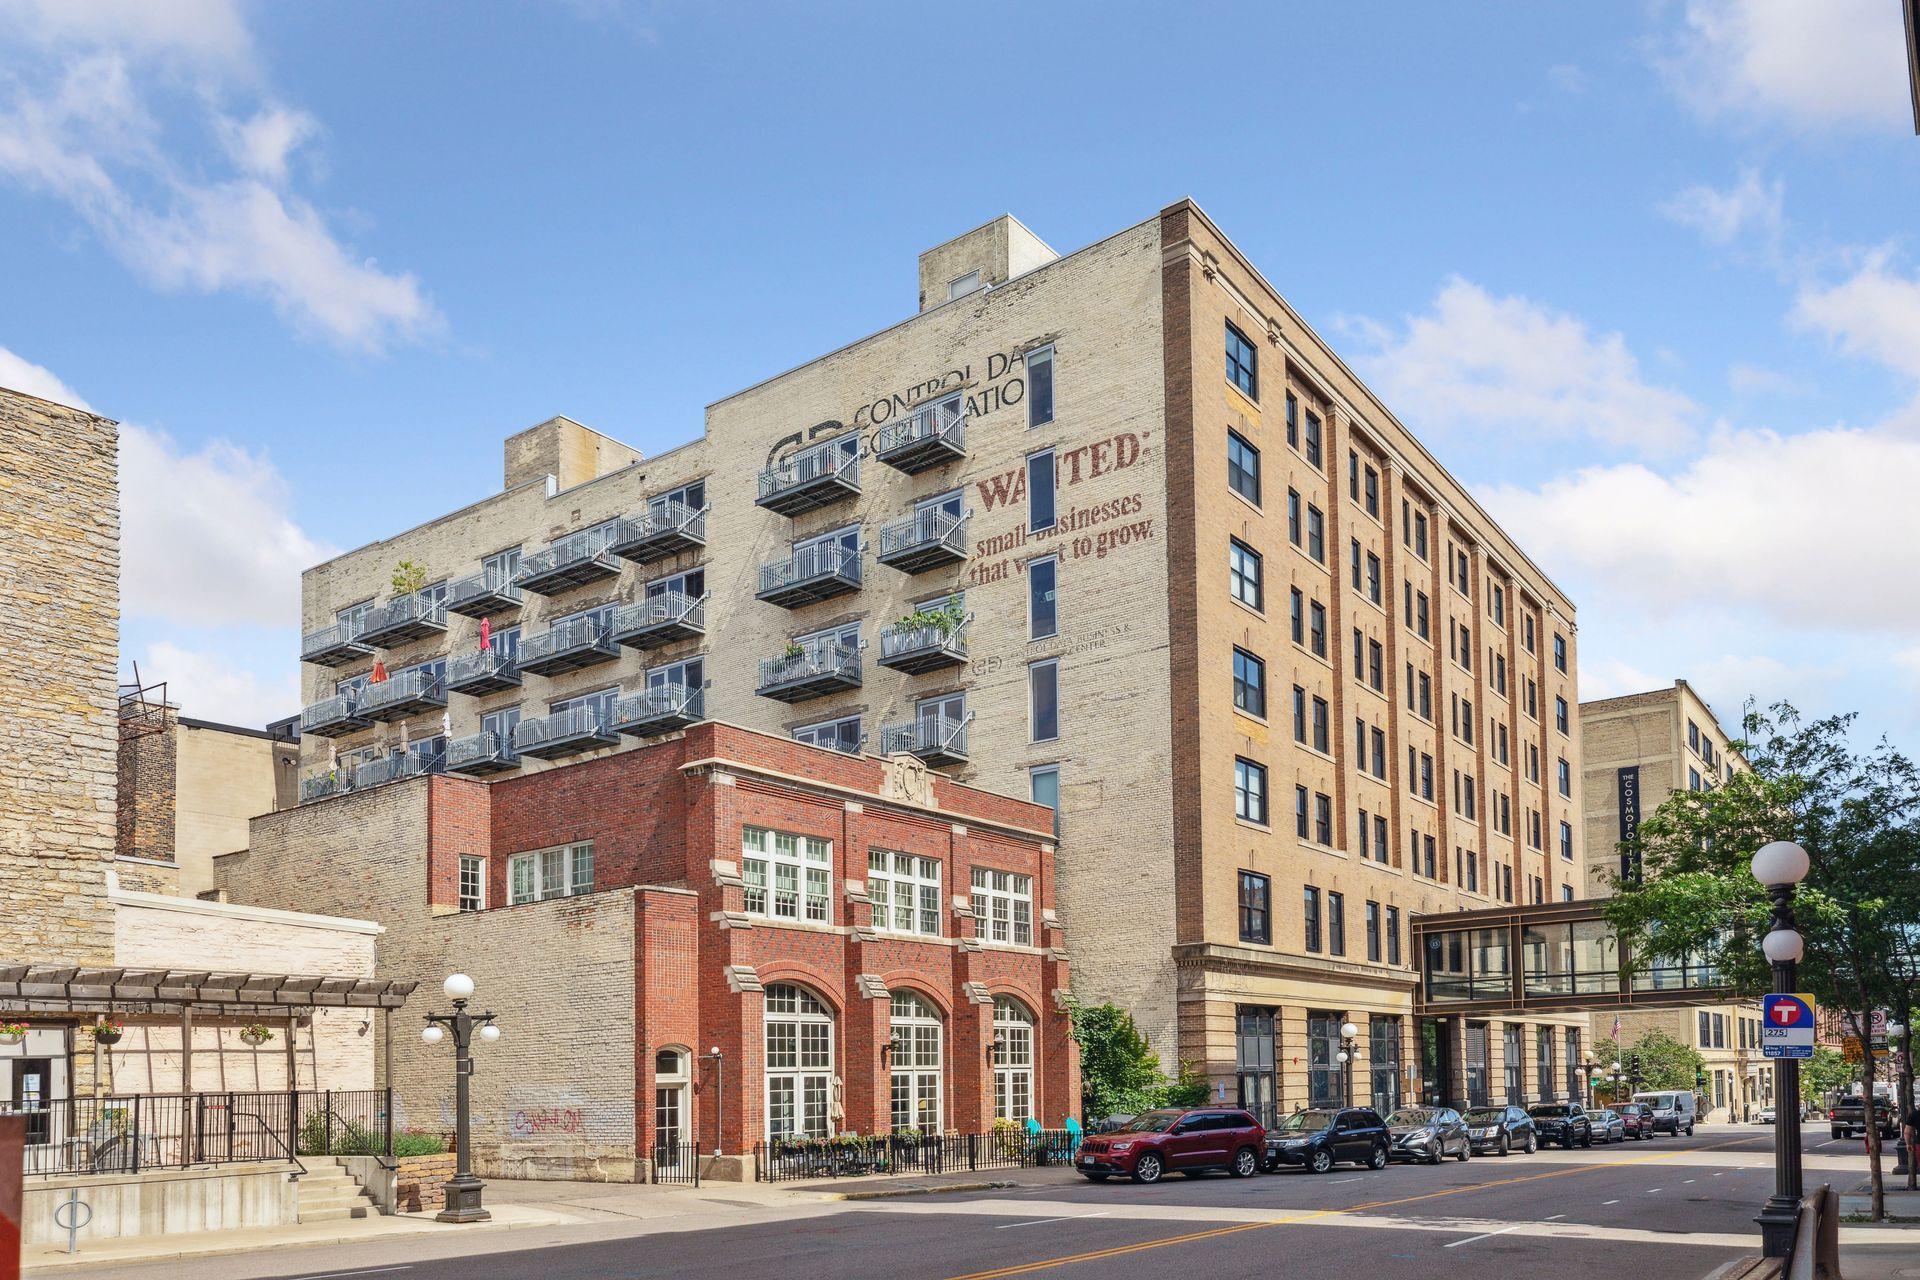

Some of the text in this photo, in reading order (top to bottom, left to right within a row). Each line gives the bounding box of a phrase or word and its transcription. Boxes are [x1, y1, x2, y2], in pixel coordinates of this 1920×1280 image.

[1036, 493, 1142, 541] usinesses
[969, 558, 1009, 585] that
[1072, 535, 1092, 560] to
[1624, 780, 1636, 881] COSMOPOITAN
[1773, 1005, 1797, 1023] T
